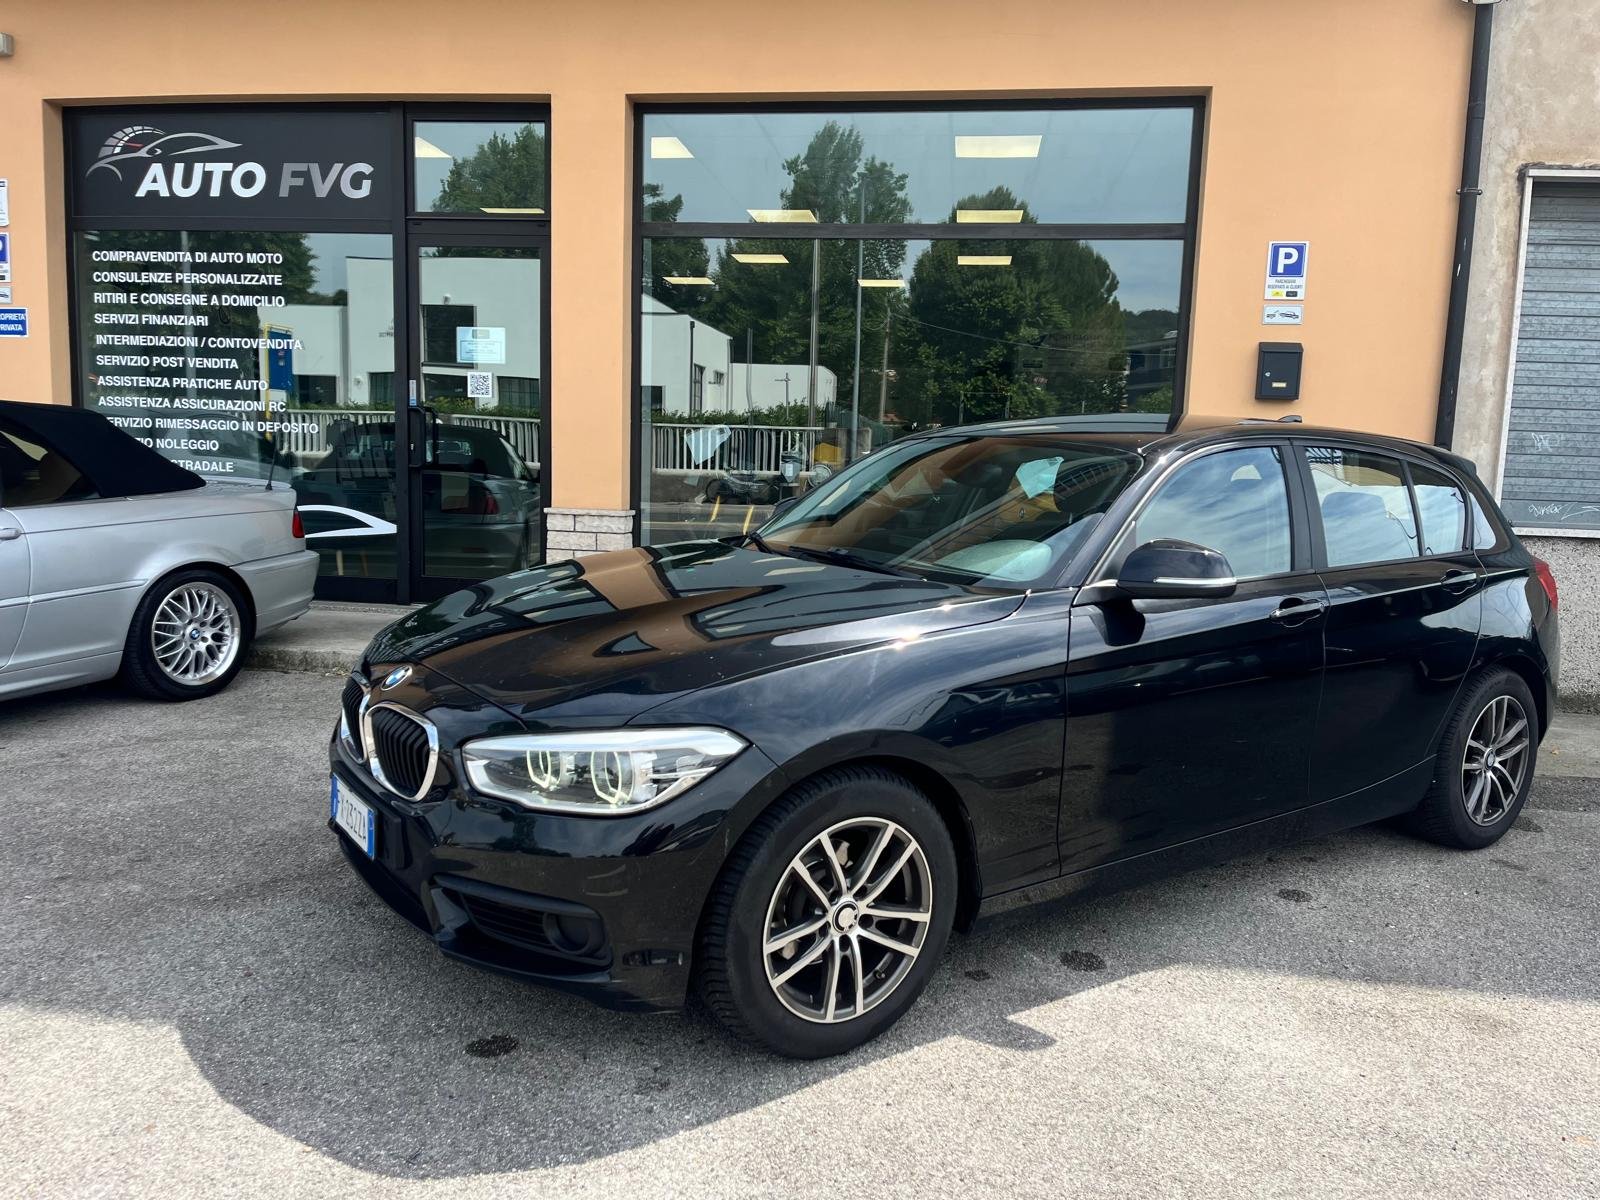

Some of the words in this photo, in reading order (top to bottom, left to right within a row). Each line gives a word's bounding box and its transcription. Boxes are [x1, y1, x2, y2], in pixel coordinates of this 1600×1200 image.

[135, 162, 266, 198] AUTO
[279, 162, 374, 199] FVG
[92, 250, 193, 262] COMPRAVENDITA
[195, 251, 207, 263] DI
[209, 252, 244, 263] AUTO
[246, 253, 283, 264] MOTO
[1277, 247, 1299, 273] P
[93, 272, 173, 283] CONSULENZE
[175, 273, 283, 286] PERSONALIZZATE
[94, 292, 127, 304] RITIRI
[130, 293, 139, 304] E
[141, 294, 208, 306] CONSEGNE
[210, 295, 219, 306] A
[221, 295, 285, 307] DOMICILIO
[94, 313, 139, 325] SERVIZI
[142, 314, 208, 327] FINANZIARI
[96, 334, 198, 347] INTERMEDIAZIONI
[200, 337, 206, 348] /
[208, 337, 303, 350] CONTOVENDITA
[96, 355, 150, 367] SERVIZIO
[153, 356, 185, 368] POST
[187, 357, 239, 369] VENDITA
[97, 375, 170, 388] ASSISTENZA
[173, 377, 232, 390] PRATICHE
[234, 379, 268, 391] AUTO
[98, 396, 171, 408] ASSISTENZA
[173, 398, 266, 412] ASSICURAZIONI
[269, 401, 287, 412] RC
[155, 418, 239, 431] RIMESSAGGIO
[242, 421, 255, 431] IN
[257, 422, 319, 434] DEPOSITO
[156, 438, 219, 451] NOLEGGIO
[171, 460, 234, 473] TRADALE
